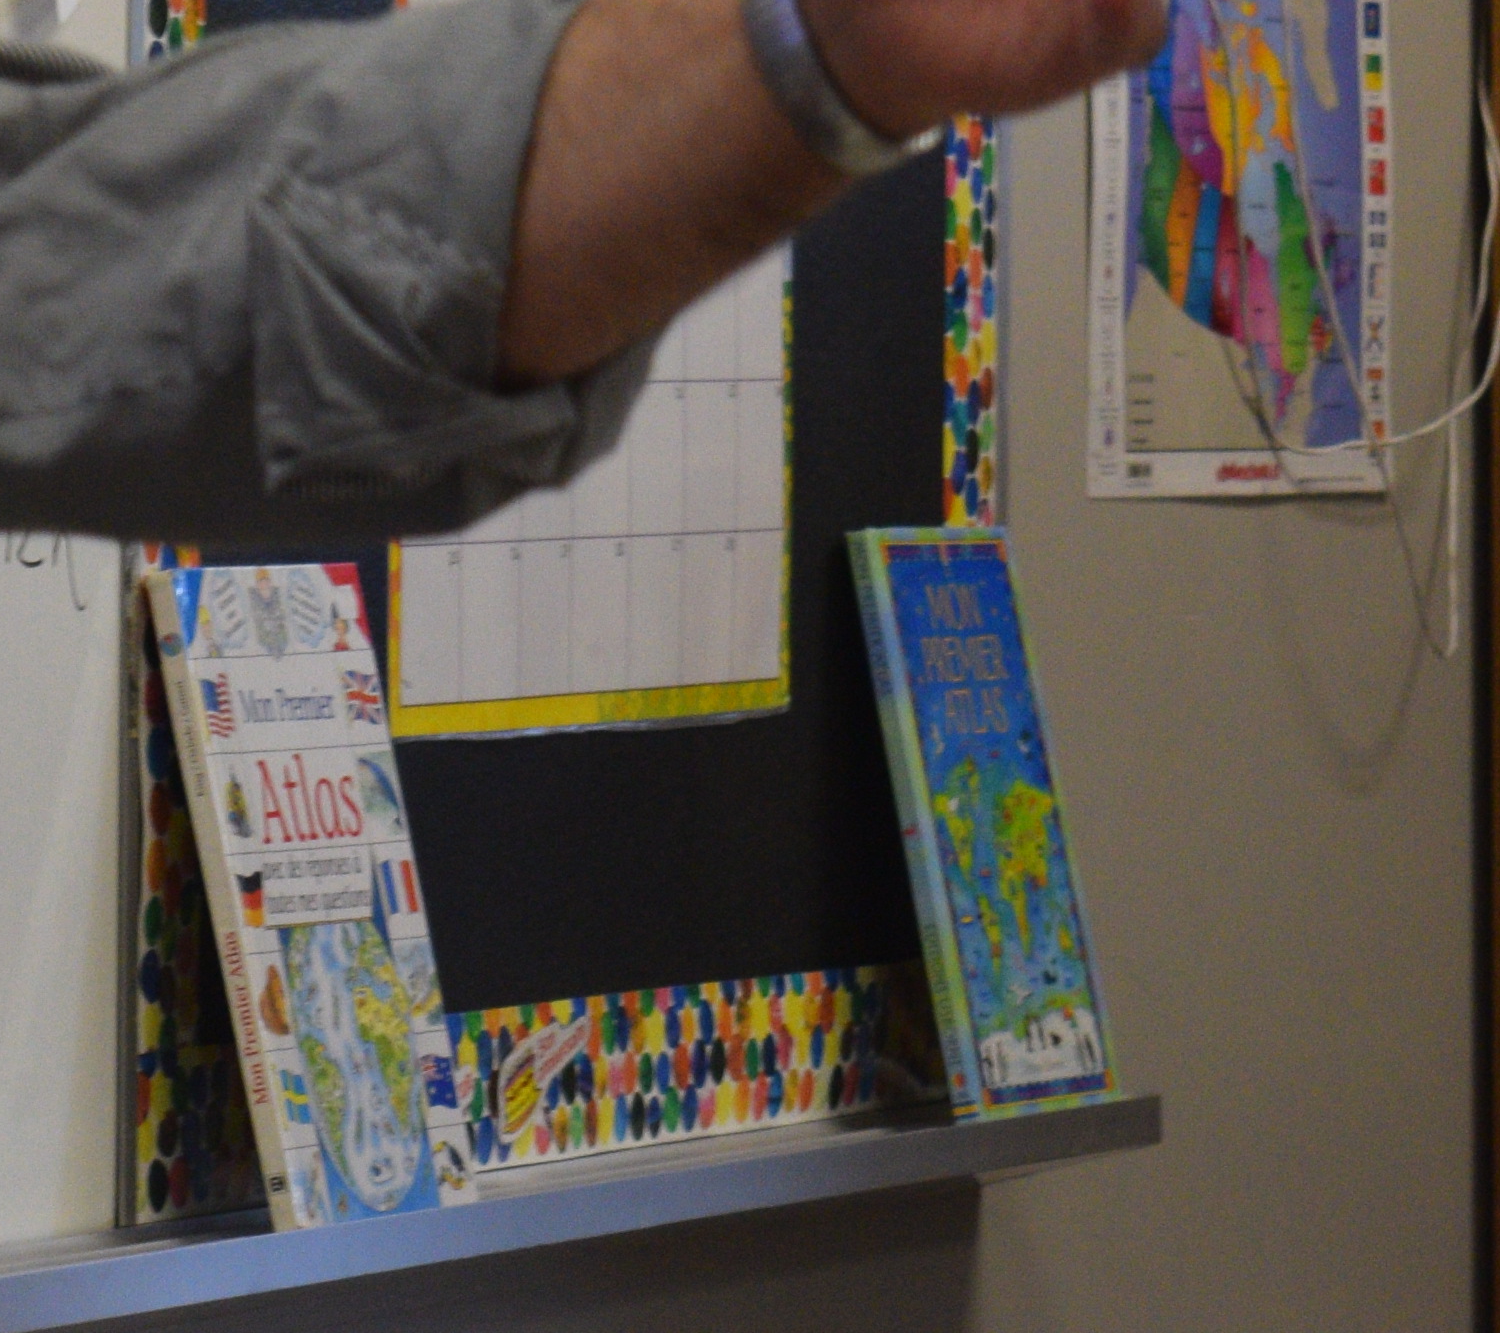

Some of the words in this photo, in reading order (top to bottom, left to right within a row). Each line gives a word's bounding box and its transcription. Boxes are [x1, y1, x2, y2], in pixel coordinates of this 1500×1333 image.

[925, 582, 984, 631] MON
[238, 689, 274, 723] Mon
[277, 686, 335, 722] Premier
[256, 752, 363, 845] Atlas
[226, 931, 244, 977] Atlas
[235, 985, 260, 1057] Premier
[253, 1062, 270, 1106] Mon
